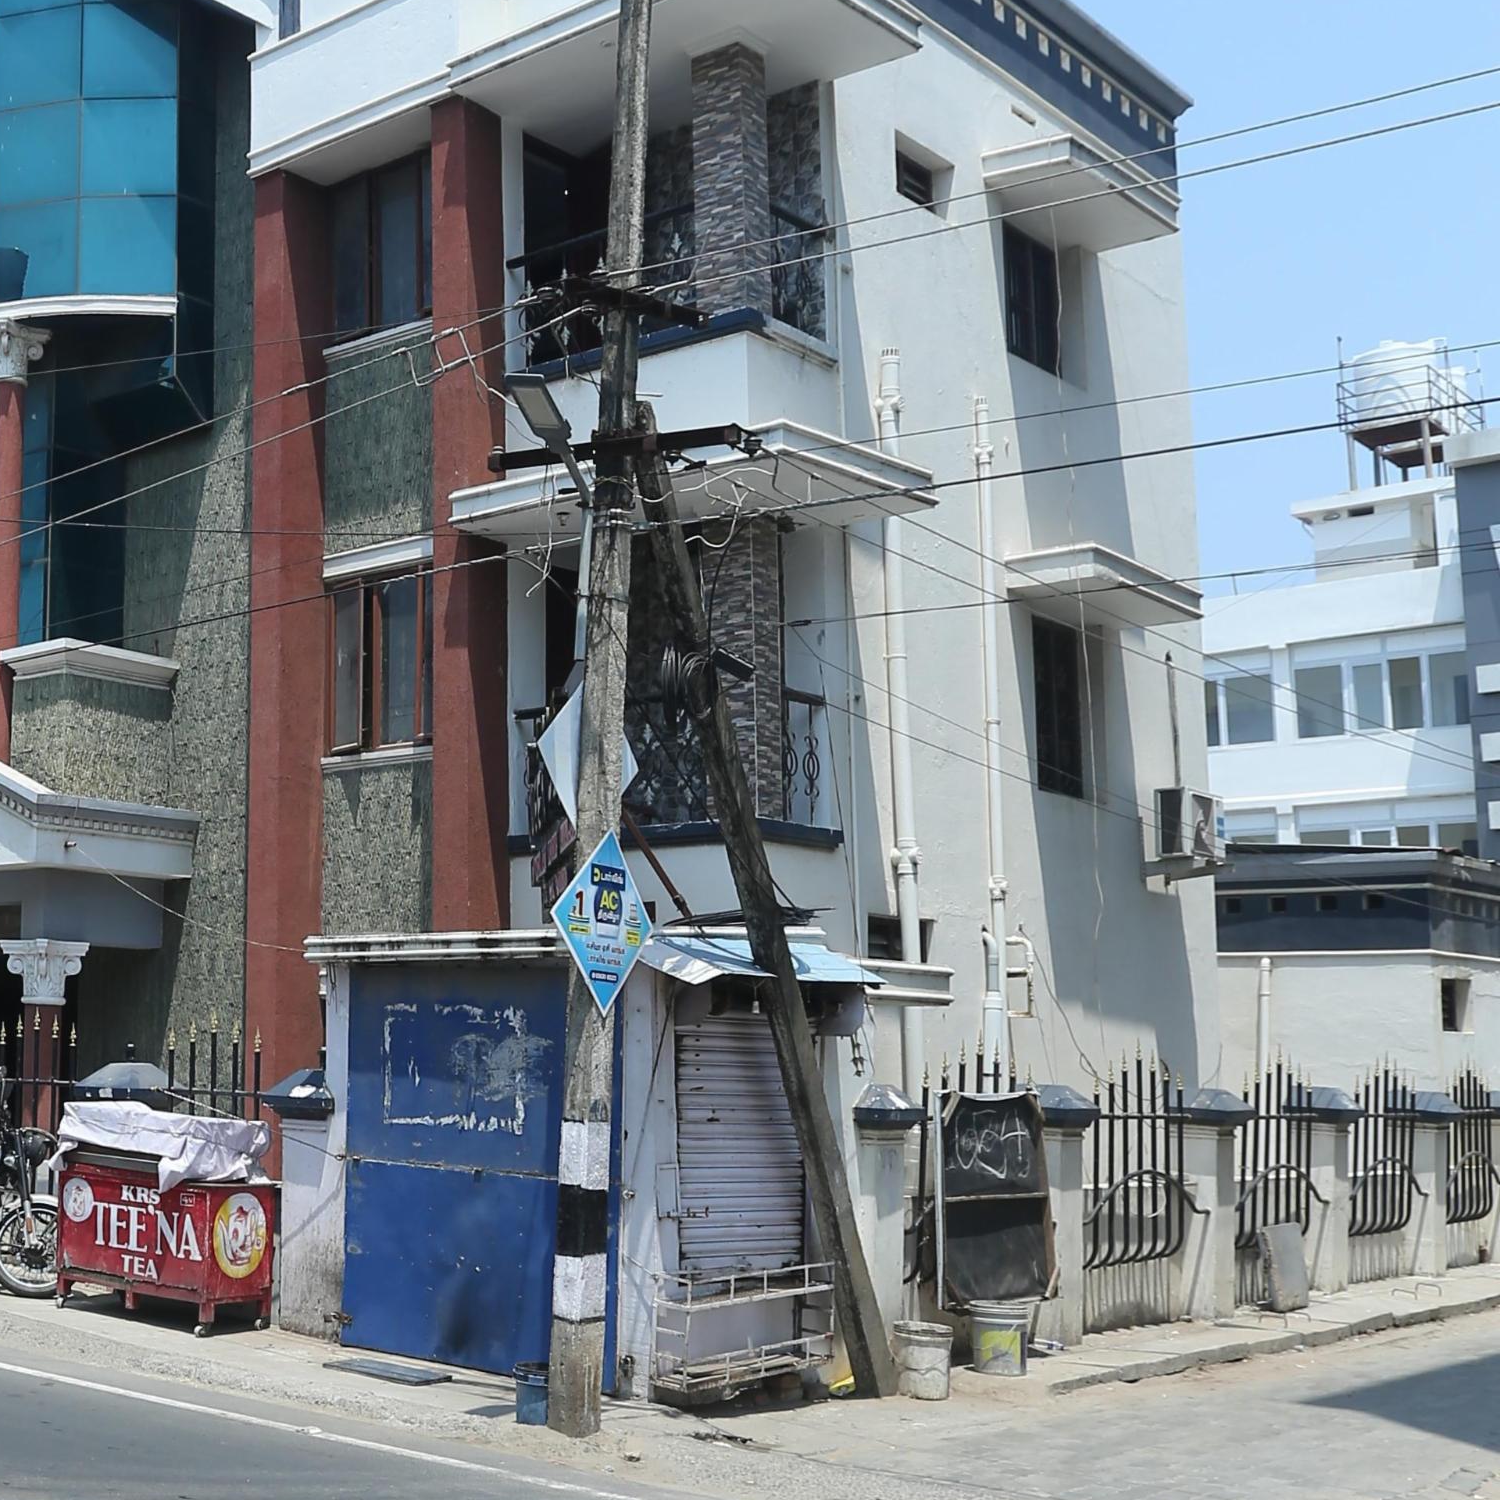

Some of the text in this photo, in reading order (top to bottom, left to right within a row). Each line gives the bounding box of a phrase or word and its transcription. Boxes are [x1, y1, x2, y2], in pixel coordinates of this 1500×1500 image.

[600, 890, 619, 910] AC
[121, 1185, 160, 1203] KRS
[121, 1254, 159, 1280] TEA
